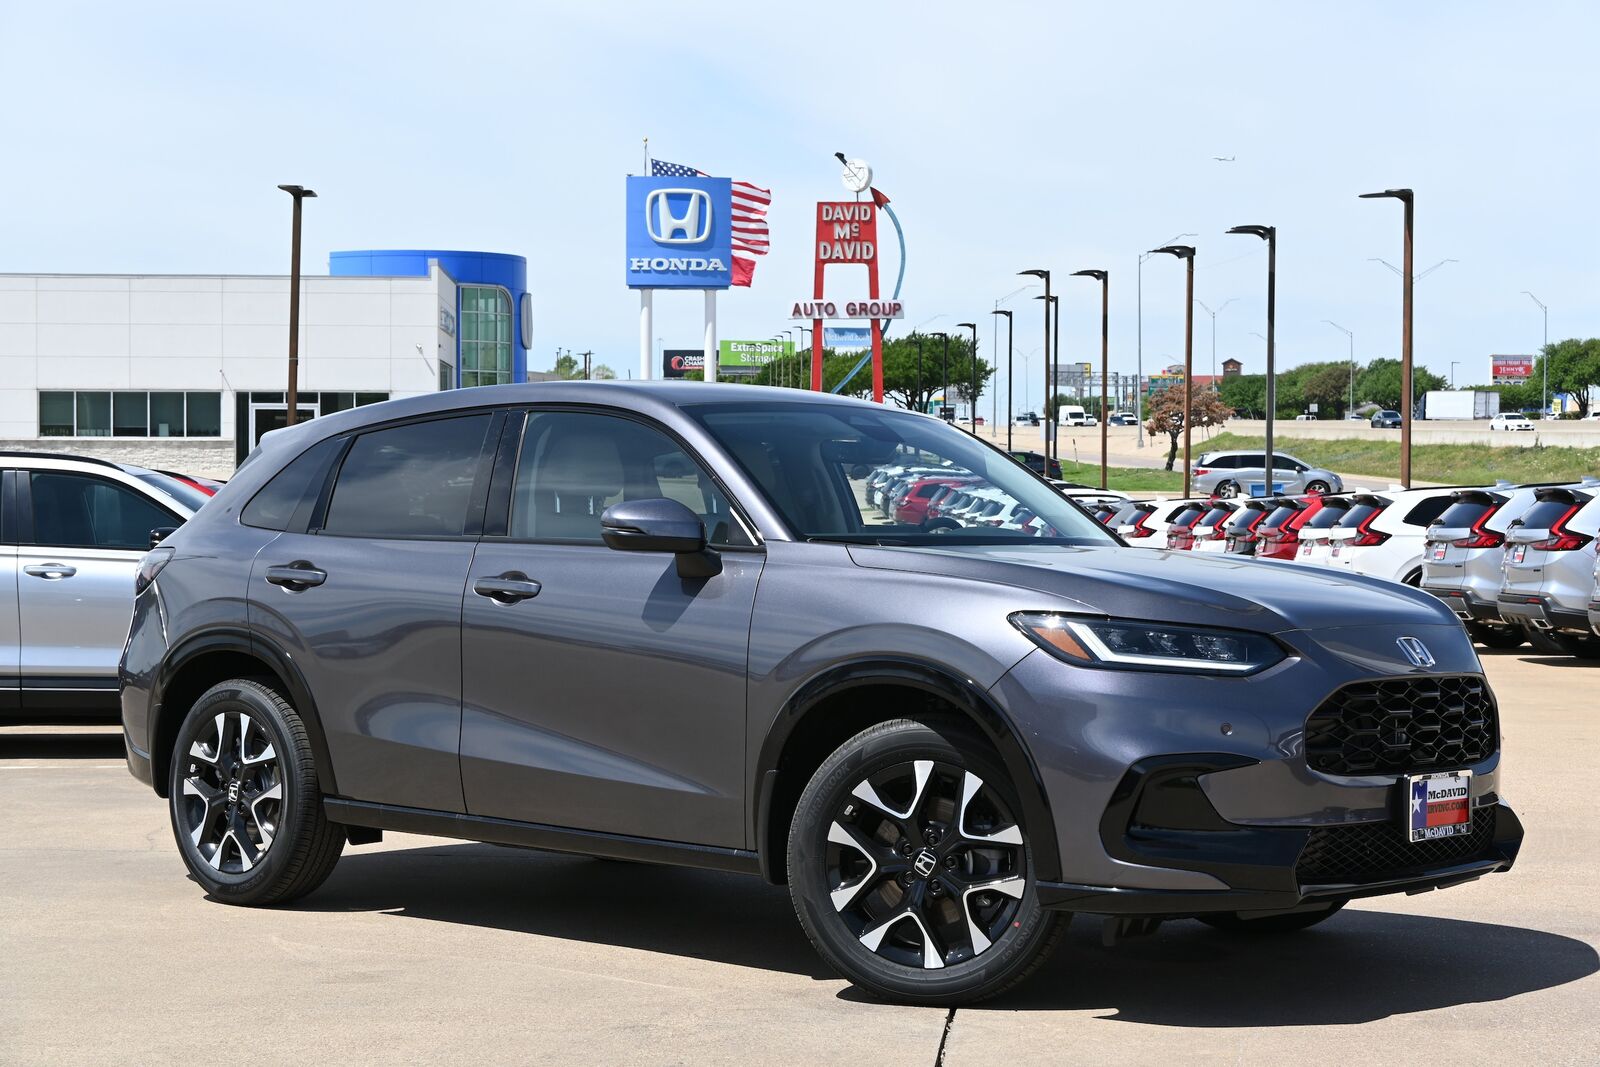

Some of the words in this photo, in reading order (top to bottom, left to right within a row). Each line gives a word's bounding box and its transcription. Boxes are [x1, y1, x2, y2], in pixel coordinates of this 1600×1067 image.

[822, 204, 871, 221] DAVID
[819, 241, 874, 260] DAVID
[629, 257, 728, 272] HONDA
[792, 302, 837, 317] AUTO
[846, 302, 902, 317] GROUP
[1428, 787, 1467, 799] McDAVID
[1425, 825, 1454, 839] McDAVID
